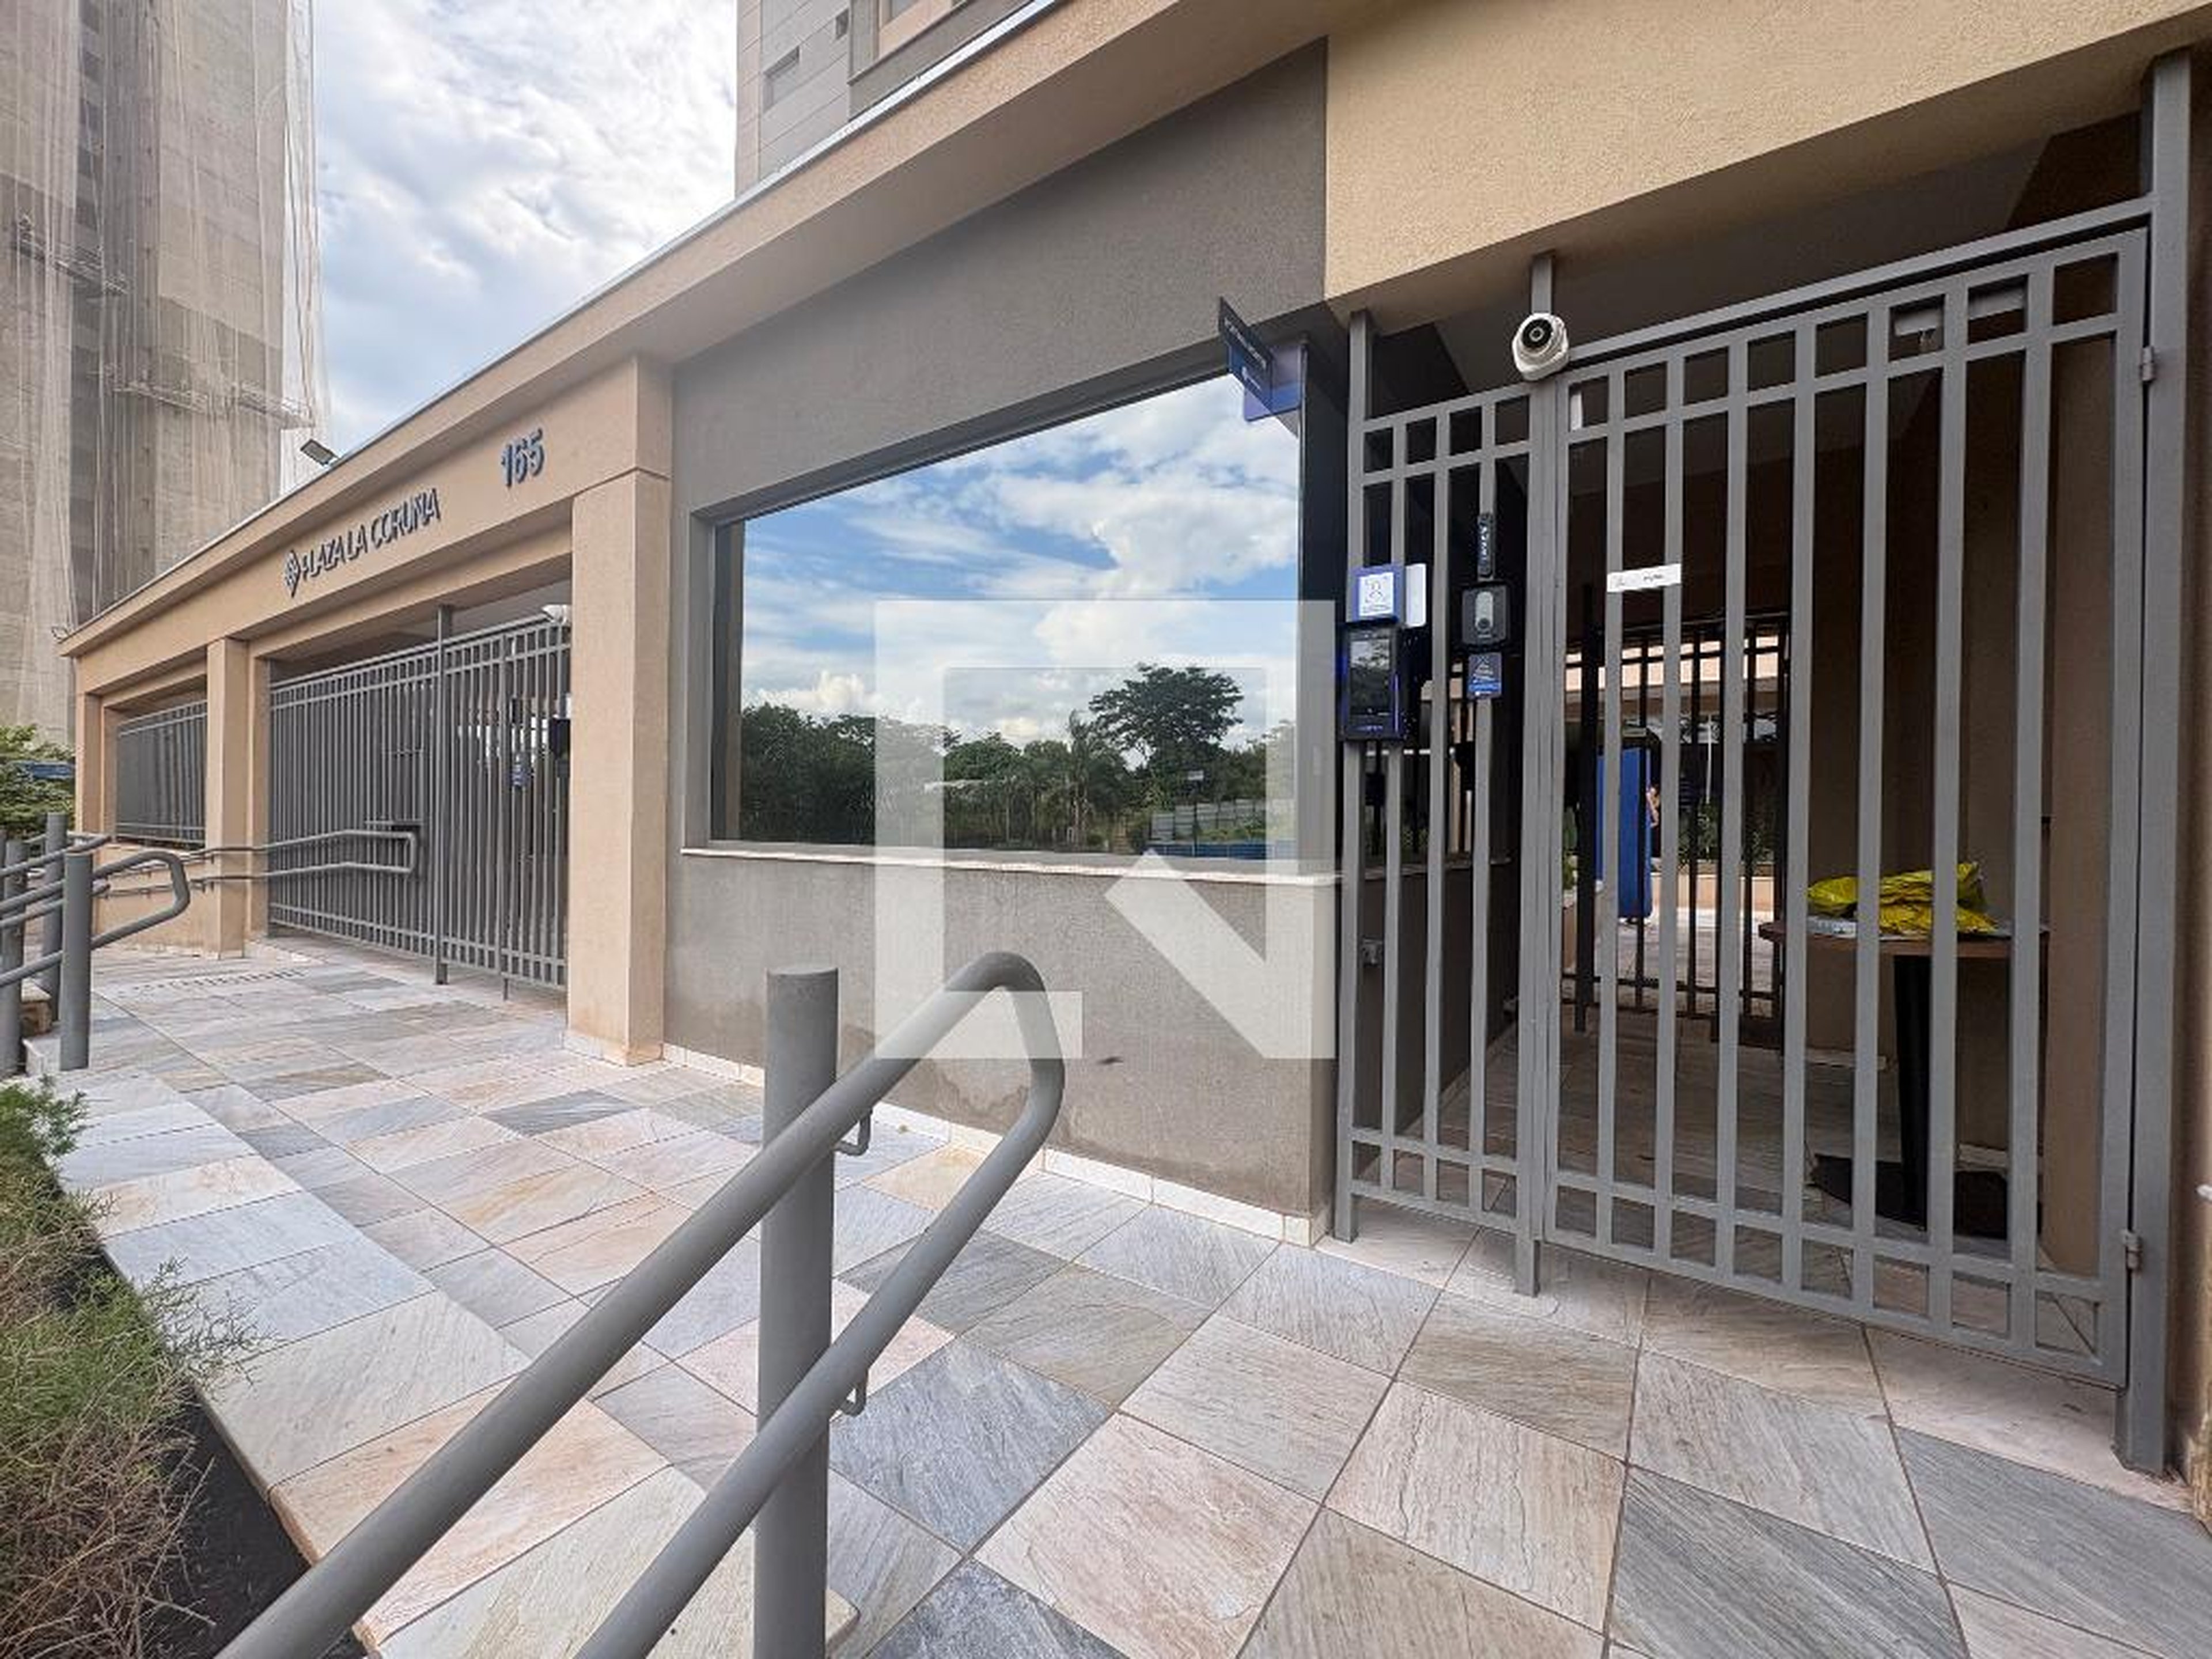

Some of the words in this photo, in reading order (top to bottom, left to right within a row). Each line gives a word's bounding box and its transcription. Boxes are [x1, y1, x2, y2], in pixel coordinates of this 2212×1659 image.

[500, 427, 544, 488] 165
[302, 535, 346, 581] PLAZA
[347, 524, 368, 560] LA
